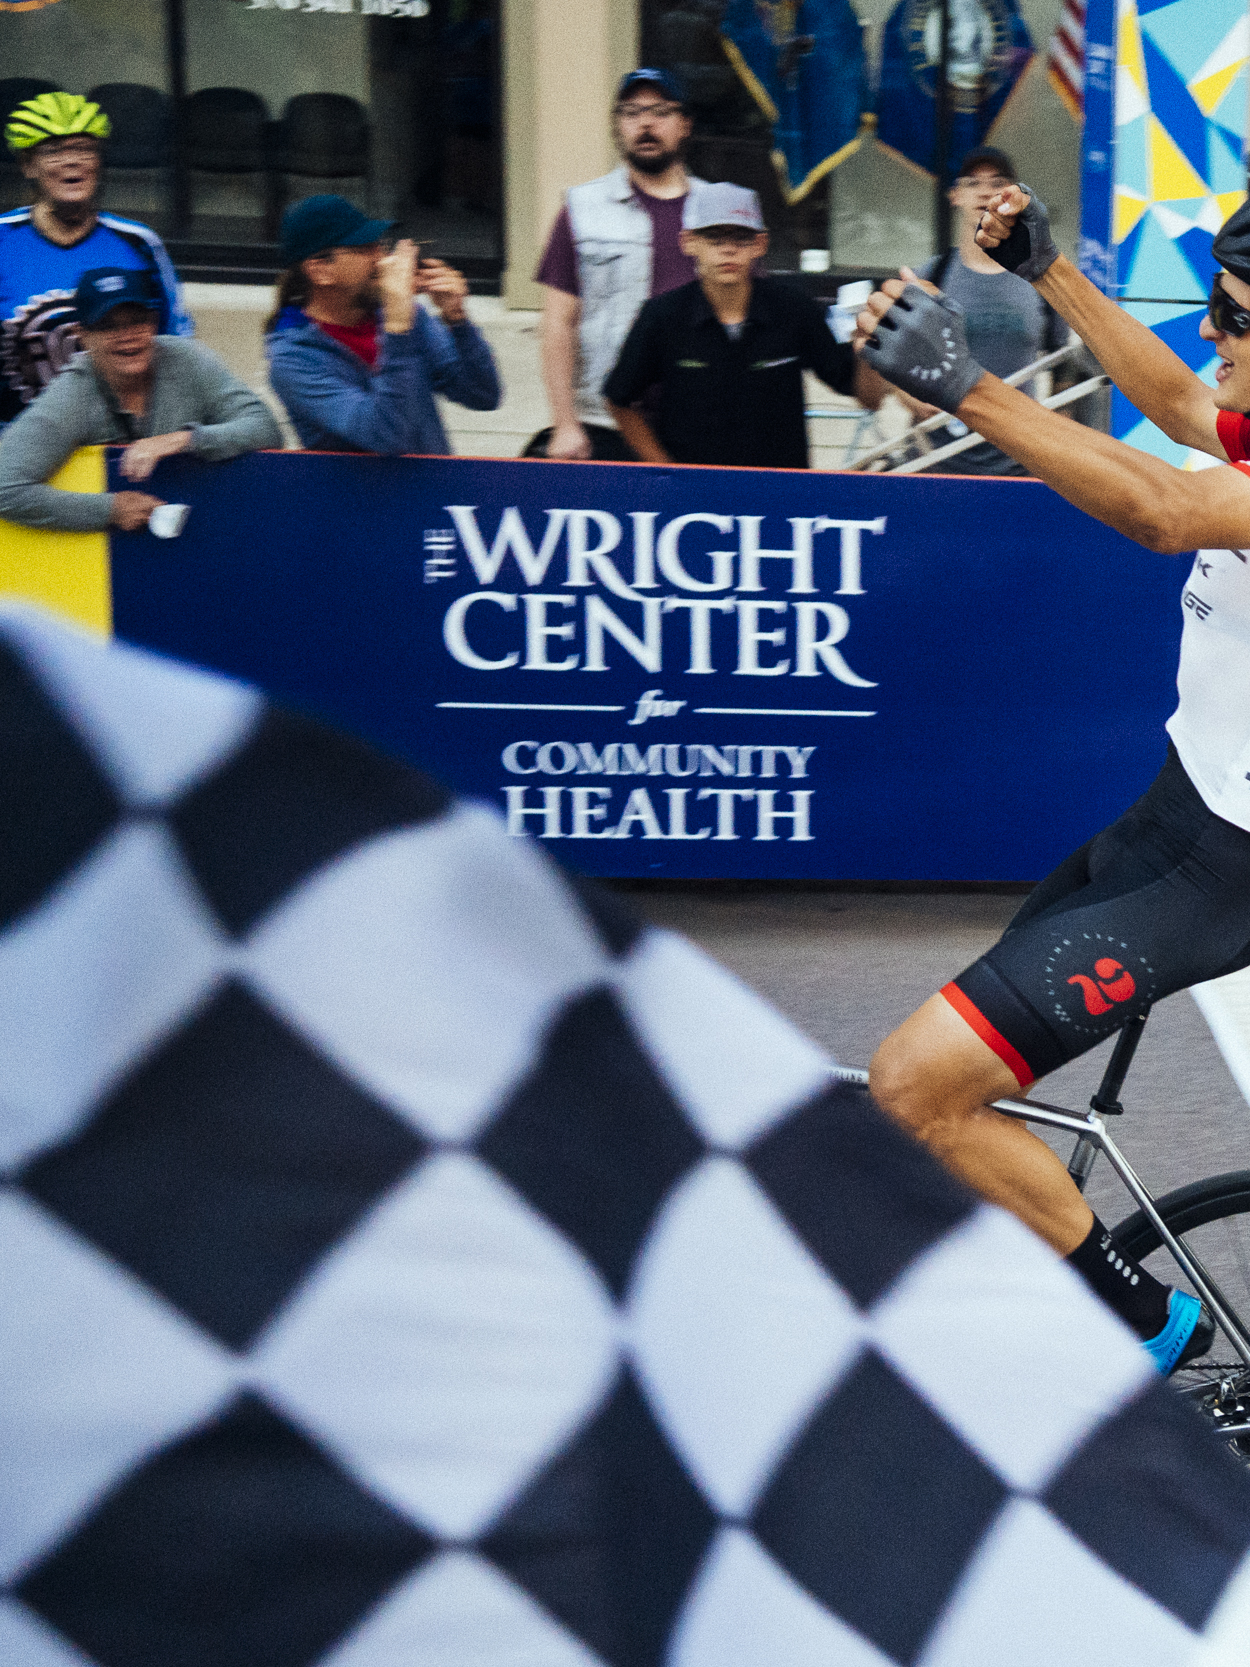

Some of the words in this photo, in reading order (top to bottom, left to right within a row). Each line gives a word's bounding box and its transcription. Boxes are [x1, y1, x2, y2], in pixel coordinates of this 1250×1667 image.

[443, 505, 888, 602] WRIGHT
[442, 590, 879, 689] CENTER
[627, 689, 687, 726] for
[501, 740, 817, 779] COMMUNITY
[500, 785, 816, 842] HEALTH
